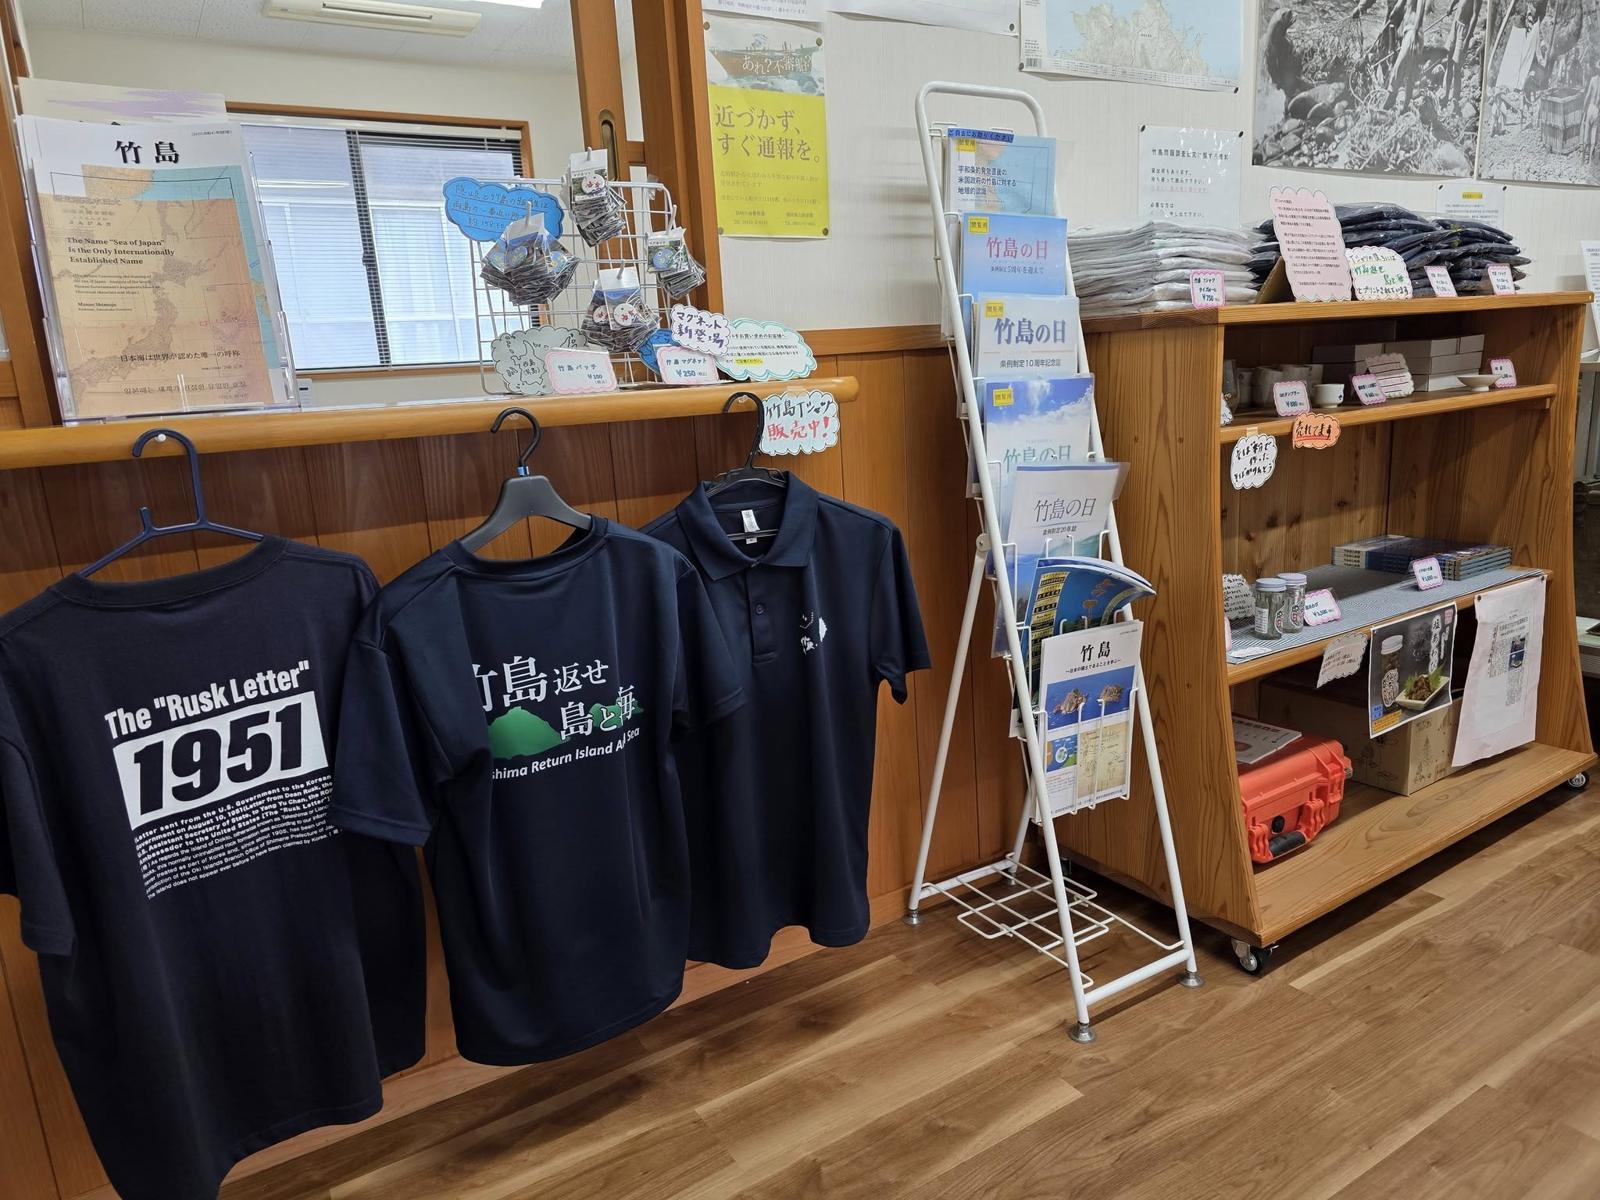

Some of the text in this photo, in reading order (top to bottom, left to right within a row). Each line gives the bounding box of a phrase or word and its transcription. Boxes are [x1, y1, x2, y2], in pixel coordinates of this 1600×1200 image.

[715, 104, 801, 134] 近づかず、
[114, 140, 180, 164] 竹島
[716, 134, 820, 163] すぐ通報を。
[92, 248, 112, 256] Only
[113, 248, 175, 257] Internationally
[986, 237, 1048, 260] 竹島の日
[676, 311, 722, 330] マグネット
[994, 318, 1066, 345] 竹島の日
[1034, 498, 1097, 522] 竹島の日
[1081, 641, 1110, 662] 竹島
[104, 660, 310, 739] The "Rusk Letter"
[133, 702, 303, 816] 1951
[531, 753, 572, 773] Return
[575, 742, 613, 761] Island
[626, 727, 640, 742] Sea
[181, 815, 201, 826] from
[203, 810, 216, 819] the
[235, 788, 280, 806] Government
[306, 775, 332, 787] Korean
[188, 818, 214, 831] August
[266, 794, 284, 803] from
[284, 791, 302, 799] Dean
[139, 843, 183, 866] Ambassador
[210, 825, 236, 838] United
[149, 835, 183, 852] Assistant
[184, 823, 220, 840] Secretary
